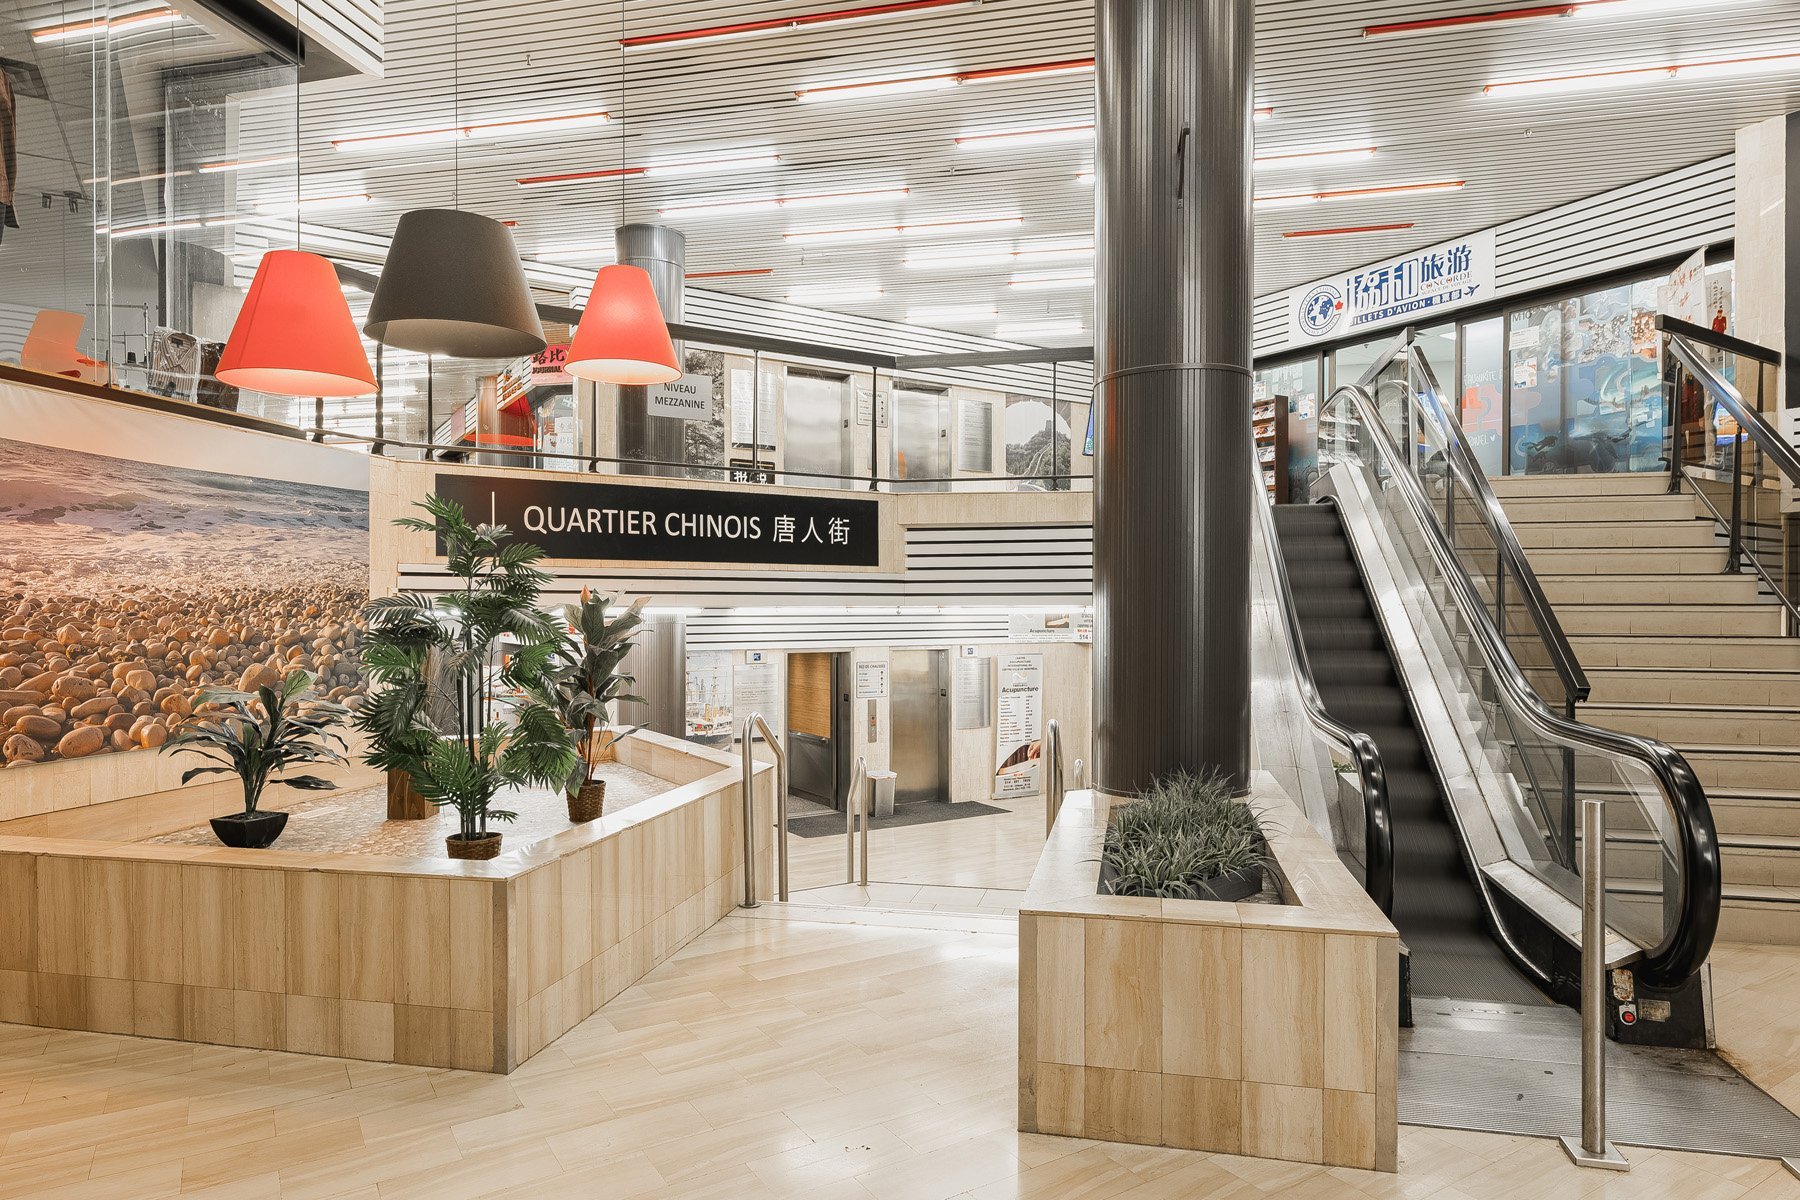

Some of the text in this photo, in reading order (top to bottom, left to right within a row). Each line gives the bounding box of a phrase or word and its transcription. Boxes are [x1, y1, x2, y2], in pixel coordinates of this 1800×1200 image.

[1420, 271, 1473, 290] CONCORDE
[1387, 299, 1426, 316] D'AVION
[532, 366, 563, 374] JOURNAL
[663, 383, 697, 395] NIVEAU
[655, 396, 705, 409] MEZZANINE
[523, 504, 851, 545] QUARTIER CHINOIS 唐人街
